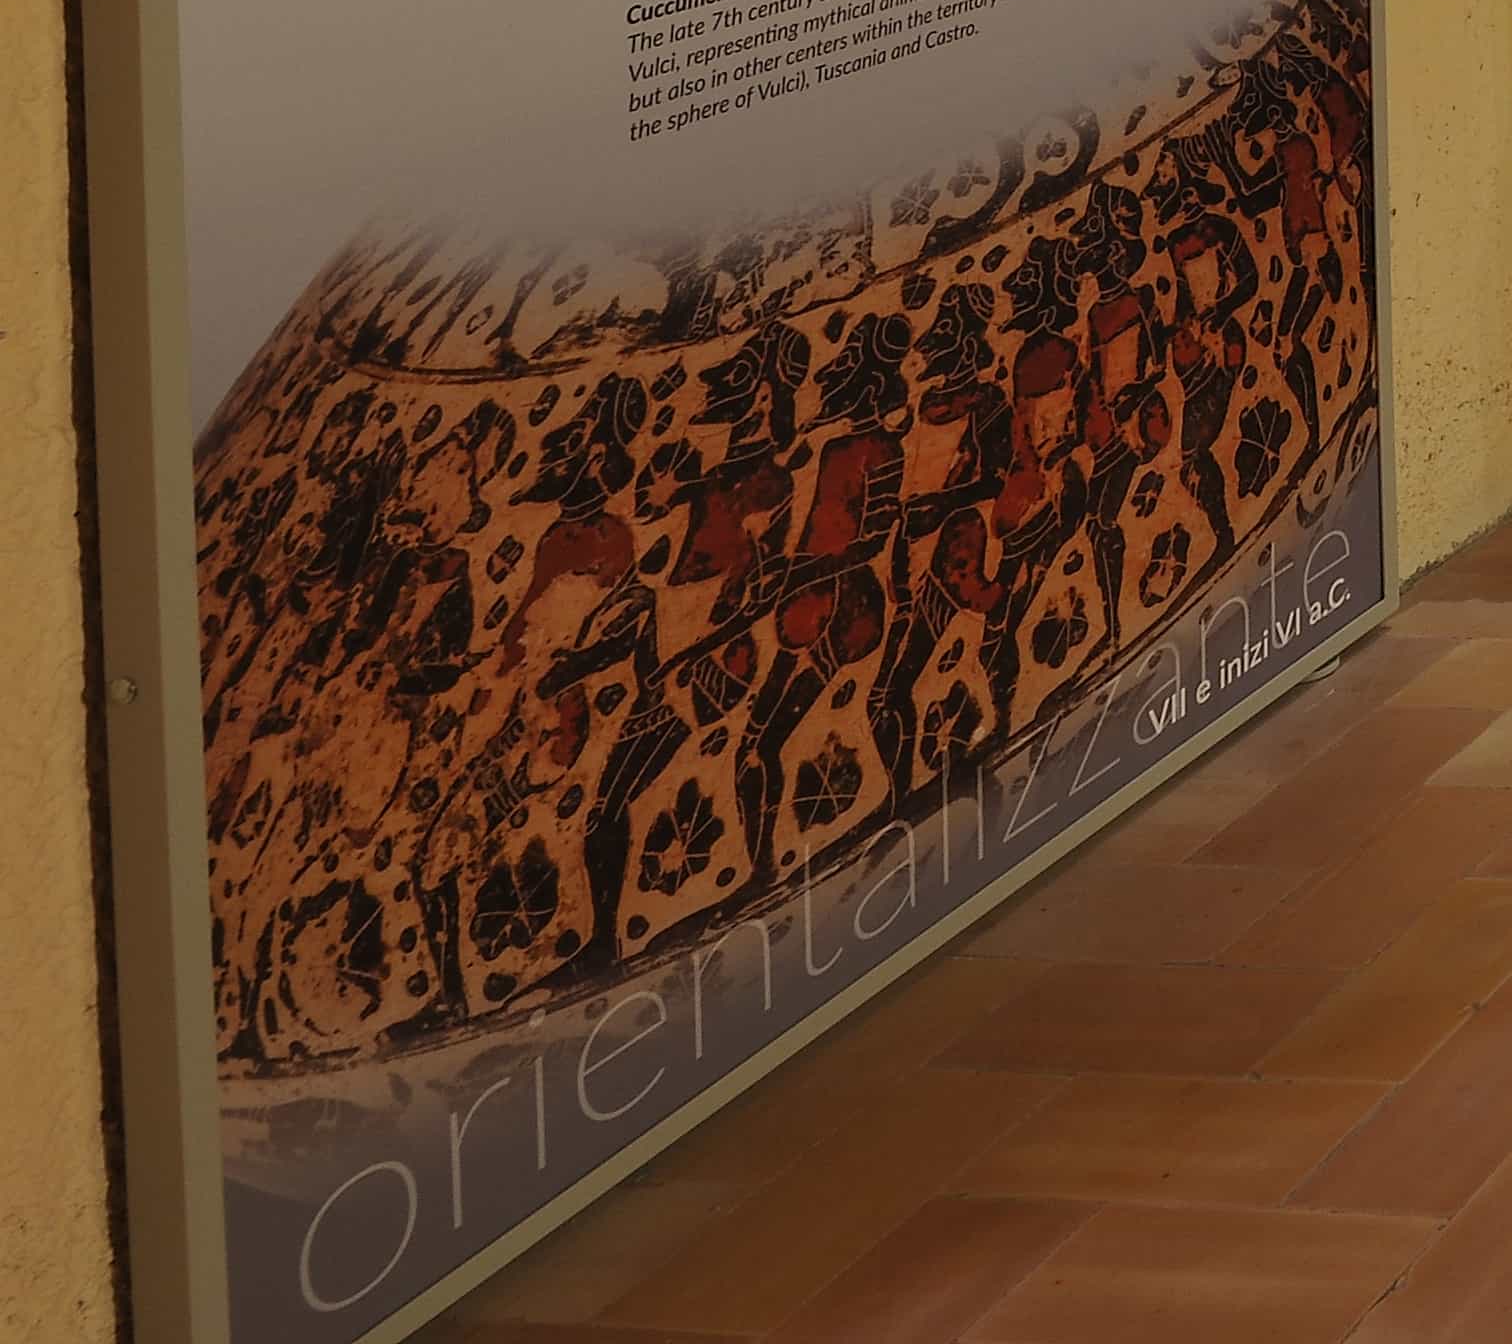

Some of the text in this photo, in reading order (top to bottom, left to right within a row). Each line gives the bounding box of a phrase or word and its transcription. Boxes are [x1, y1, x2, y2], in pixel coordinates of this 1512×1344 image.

[630, 23, 979, 142] the sphere of Vulci), Tuscania and Castro.
[1149, 577, 1352, 734] VII e inizi VI a.C.
[298, 530, 1350, 1313] orientalizzante
